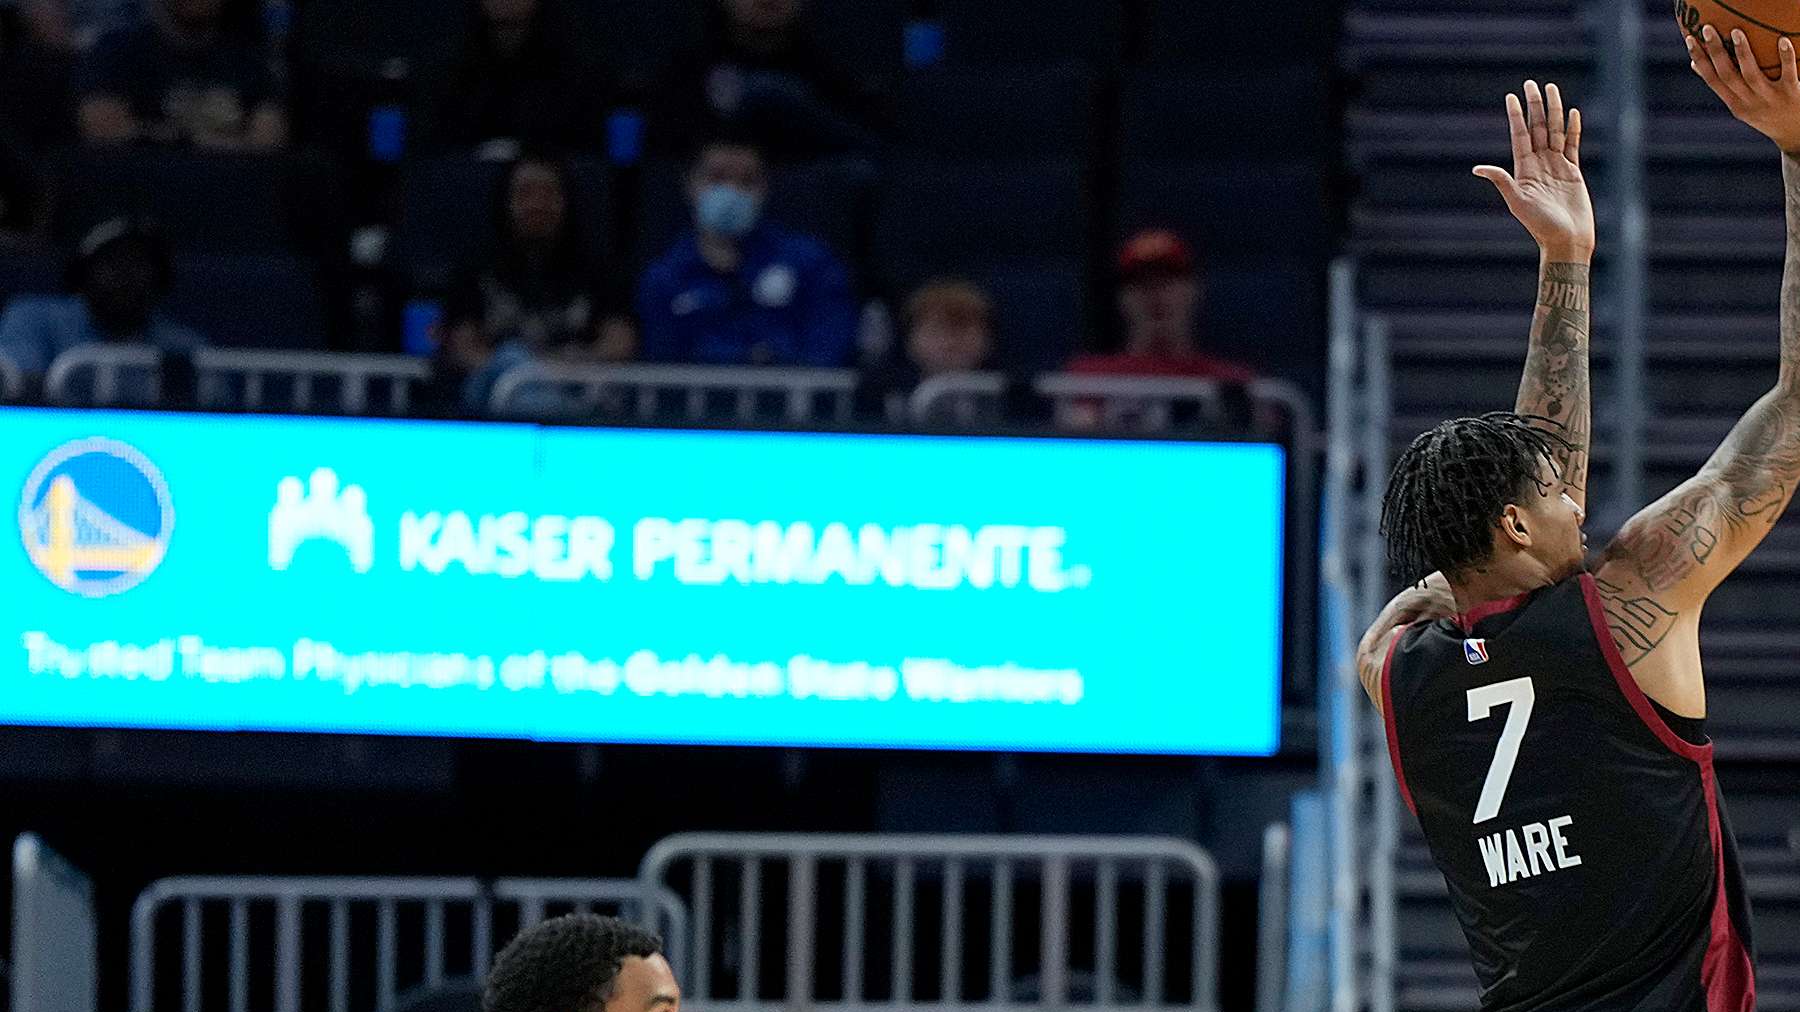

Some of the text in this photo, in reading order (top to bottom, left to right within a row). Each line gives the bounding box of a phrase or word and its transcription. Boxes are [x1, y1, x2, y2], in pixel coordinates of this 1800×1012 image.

[400, 511, 614, 582] KAISER
[177, 634, 286, 683] Team
[292, 637, 496, 695] Physicians
[501, 650, 547, 691] of
[550, 650, 622, 695] the
[624, 649, 783, 699] Golden
[787, 653, 898, 701] State
[900, 656, 1084, 705] Warriors
[1467, 677, 1535, 825] 7
[1477, 815, 1582, 888] WARE
